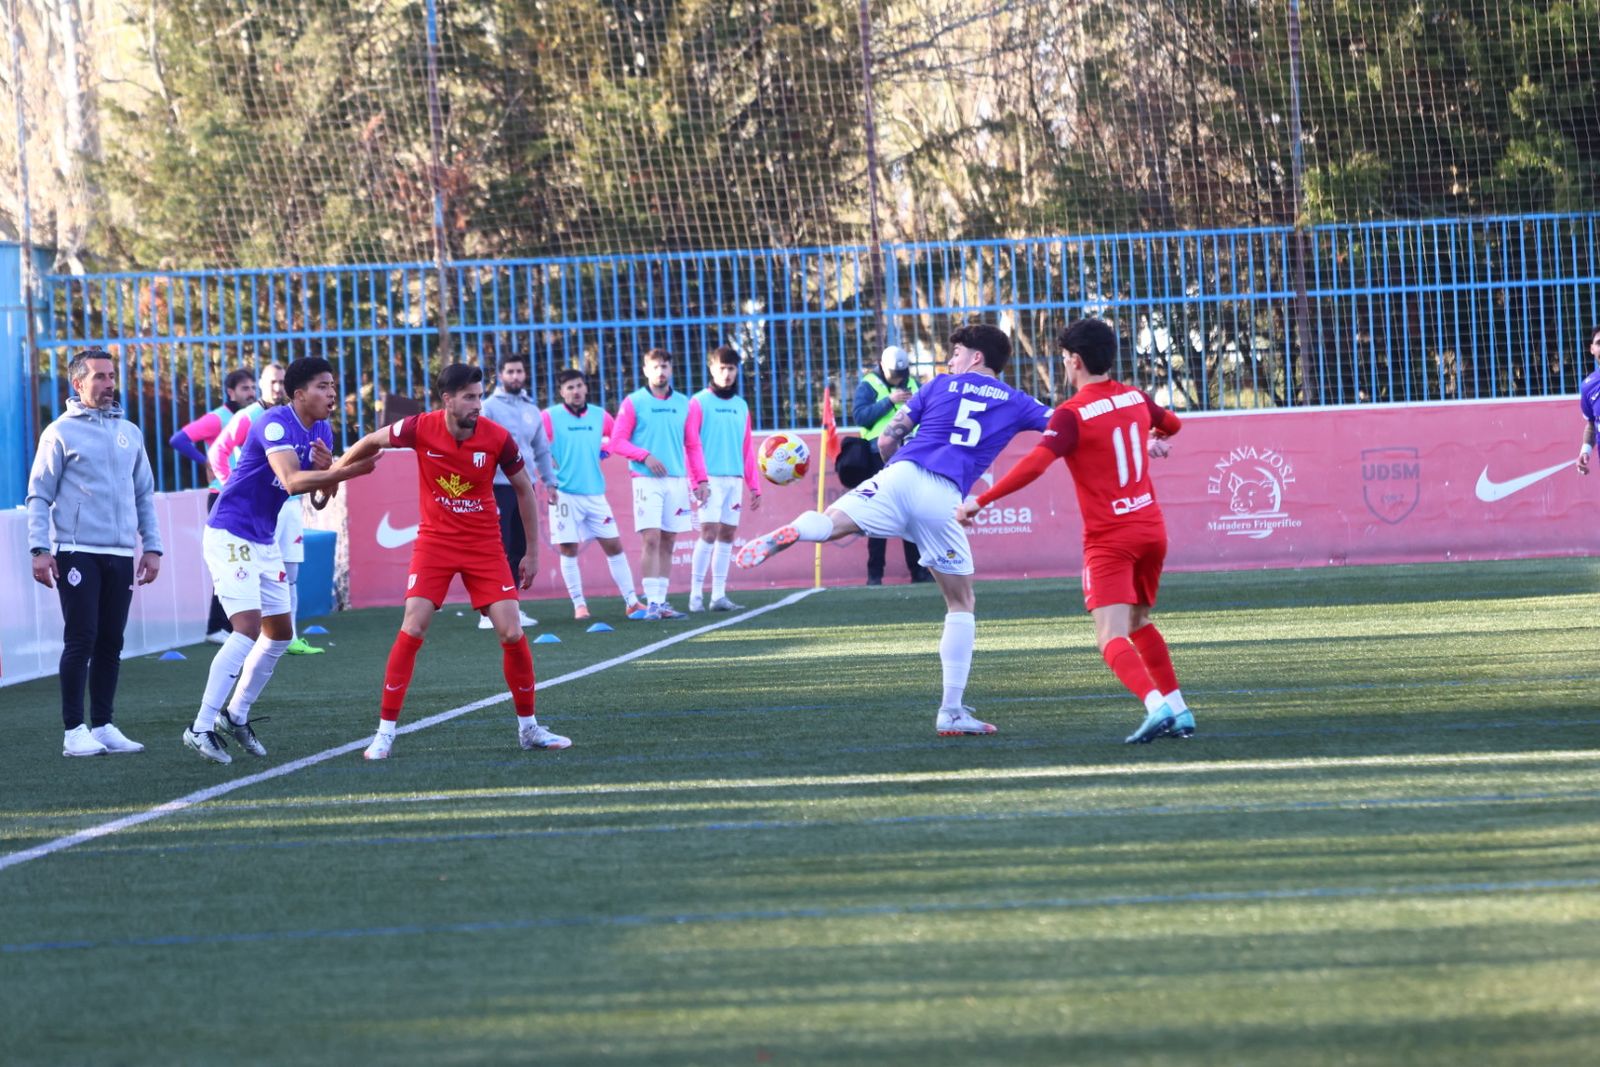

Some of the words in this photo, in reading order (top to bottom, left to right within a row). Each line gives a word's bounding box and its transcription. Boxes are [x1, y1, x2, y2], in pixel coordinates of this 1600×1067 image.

[1078, 398, 1114, 421] DAVID
[949, 397, 988, 448] 5
[1112, 421, 1143, 488] 11
[1361, 462, 1420, 481] UDSM
[974, 506, 1032, 526] casa
[1207, 521, 1252, 531] Matadero
[226, 543, 251, 562] 18
